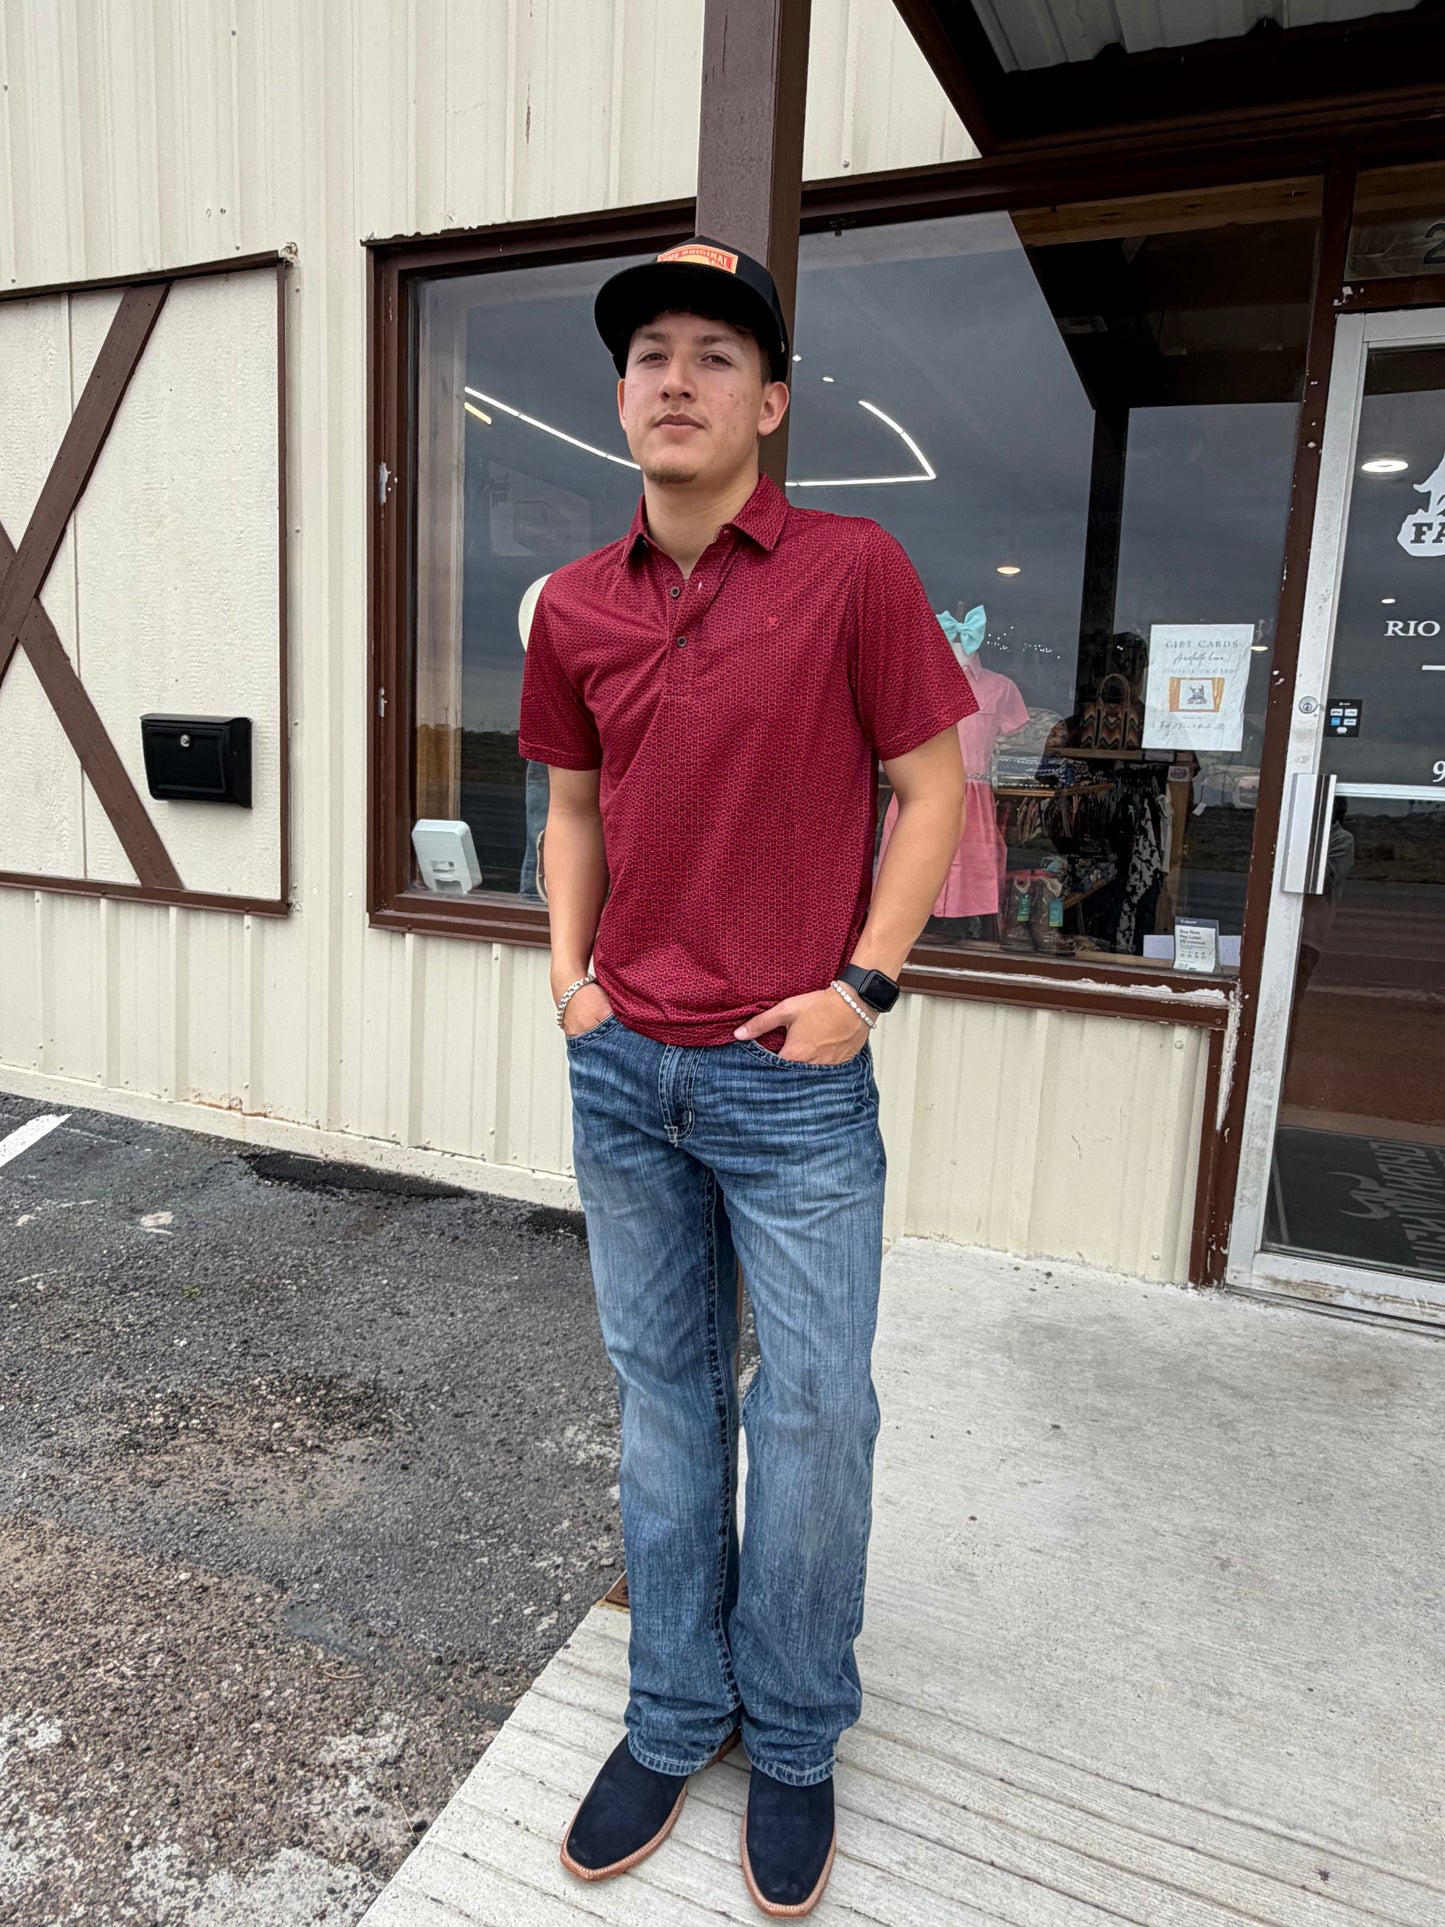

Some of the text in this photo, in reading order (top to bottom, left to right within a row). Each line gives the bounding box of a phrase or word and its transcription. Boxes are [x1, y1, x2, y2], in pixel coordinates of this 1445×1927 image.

[681, 249, 728, 267] ORIGINAL
[1384, 620, 1440, 637] RIO
[1165, 640, 1239, 649] GIFT CARDS
[1432, 760, 1445, 782] 9
